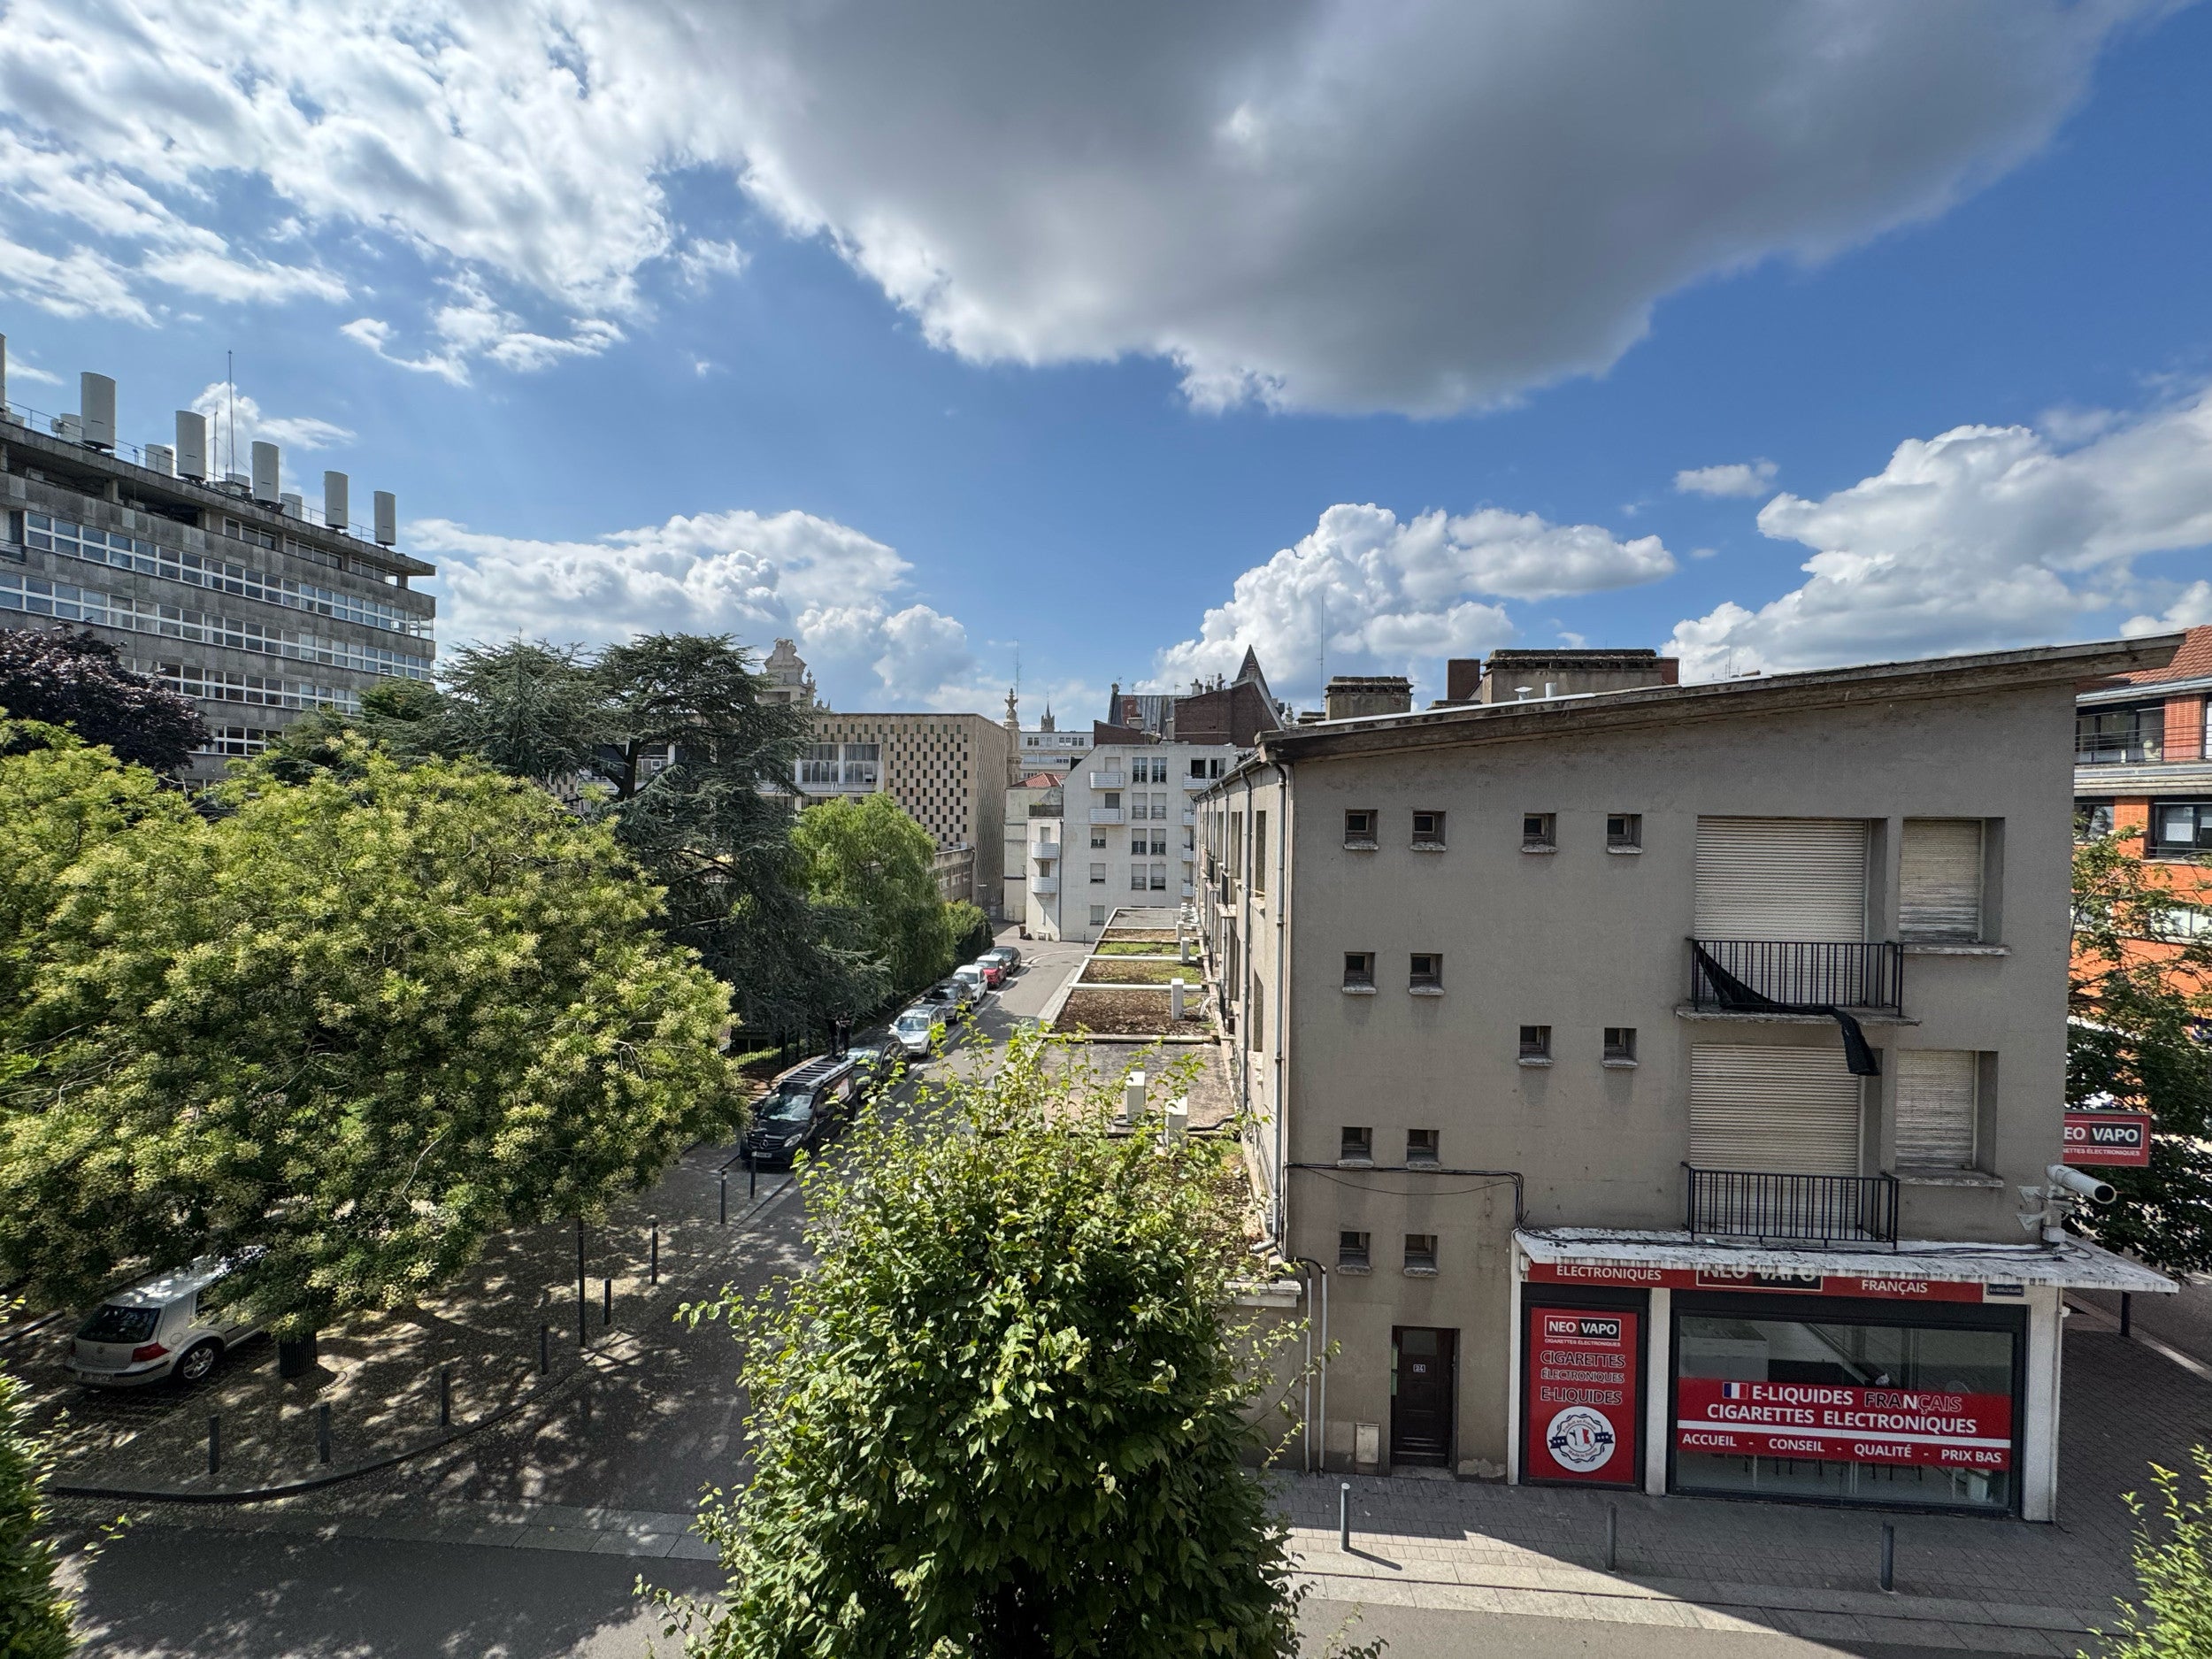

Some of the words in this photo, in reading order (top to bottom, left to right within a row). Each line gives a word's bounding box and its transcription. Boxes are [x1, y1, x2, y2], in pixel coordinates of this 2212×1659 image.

[2092, 1127, 2139, 1142] VAPO
[1862, 1279, 1928, 1294] FRANÇAIS
[1548, 1321, 1576, 1333] NEO
[1581, 1323, 1617, 1335] VAPO
[1540, 1350, 1625, 1368] CIGARETTES
[1540, 1367, 1624, 1384] ÉLECTRONIQUES
[1540, 1386, 1622, 1405] E-LIQUIDES
[1752, 1386, 1854, 1405] E-LIQUIDES
[1864, 1391, 1962, 1415] FRANÇAIS
[1707, 1404, 1815, 1424] CIGARETTES
[1824, 1410, 1978, 1435] ELECTRONIQUES
[1682, 1433, 1737, 1447] ACCUEIL
[1769, 1438, 1825, 1452] CONSEIL
[1854, 1443, 1912, 1457] QUALITÉ
[1941, 1448, 1972, 1462] PRIX
[1975, 1451, 2001, 1463] BAS
